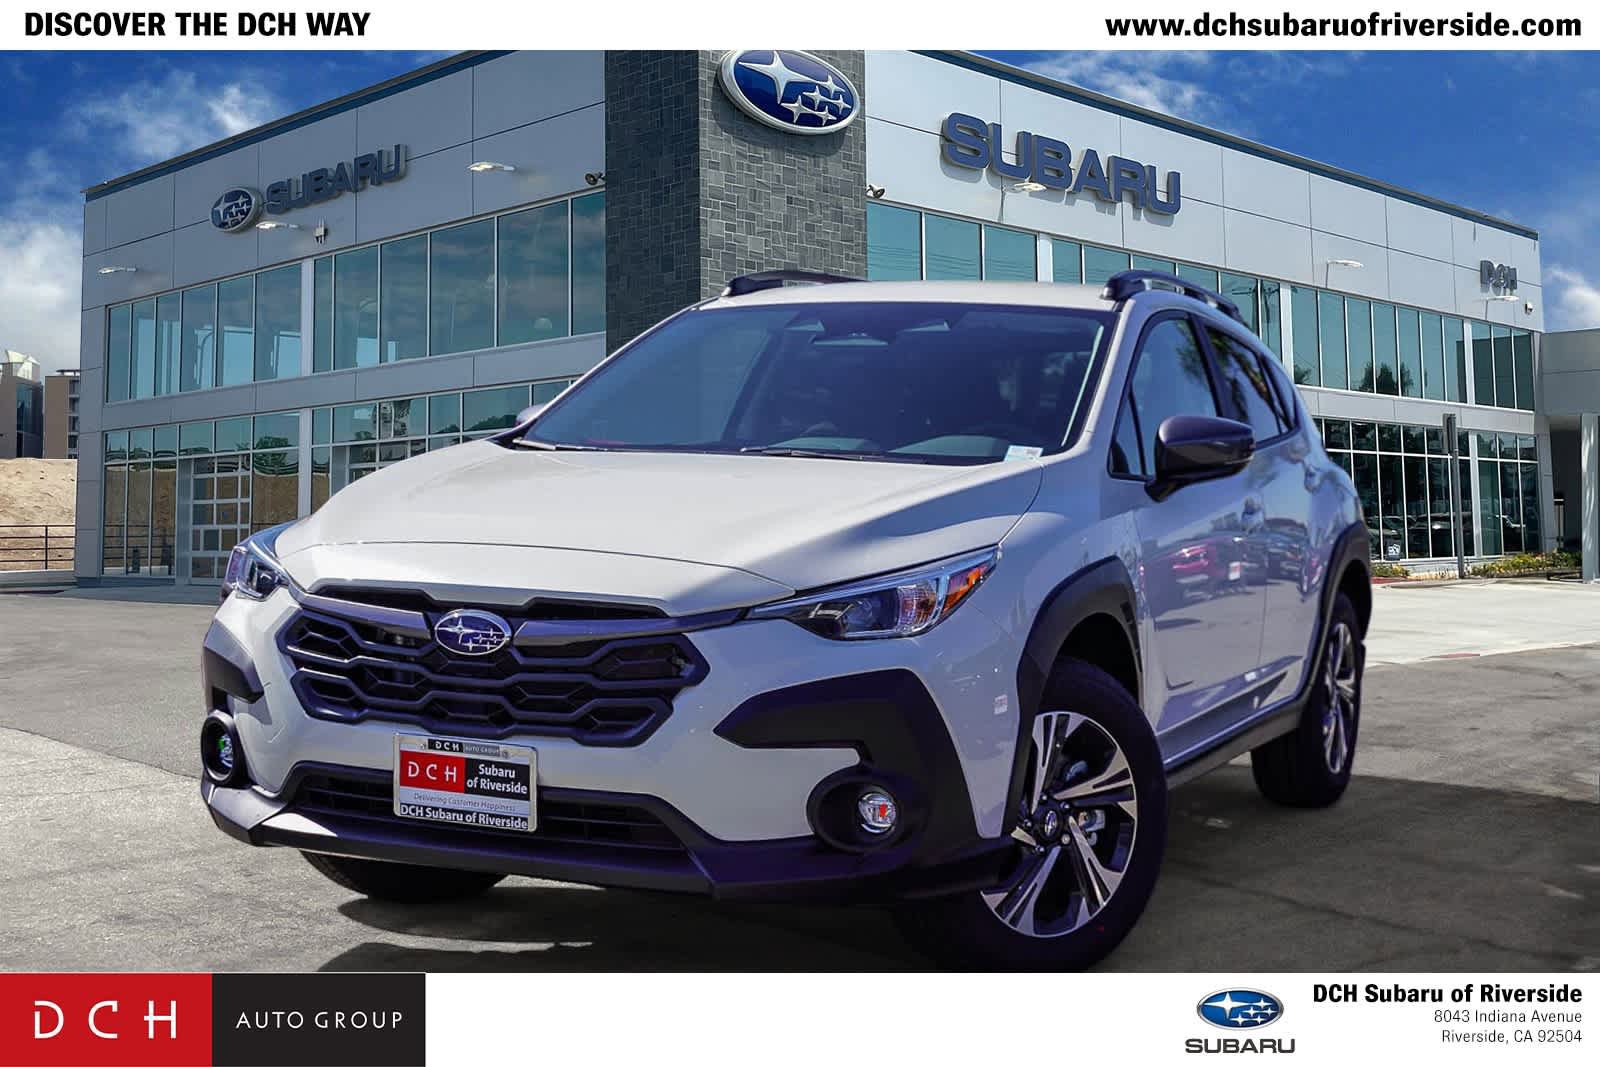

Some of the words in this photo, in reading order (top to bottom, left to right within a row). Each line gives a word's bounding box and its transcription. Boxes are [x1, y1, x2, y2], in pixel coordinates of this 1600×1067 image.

[942, 112, 1182, 215] SUBARU
[265, 144, 407, 215] SUBARU
[435, 740, 460, 752] DCH
[408, 760, 457, 784] DCH
[478, 763, 516, 779] Subaru
[466, 777, 478, 789] of
[480, 778, 528, 795] Riverside
[414, 792, 447, 805] Delivering
[448, 796, 480, 808] Customer
[400, 804, 424, 817] DCH
[425, 807, 463, 821] Subaru
[465, 812, 477, 823] of
[478, 813, 529, 829] Riverside
